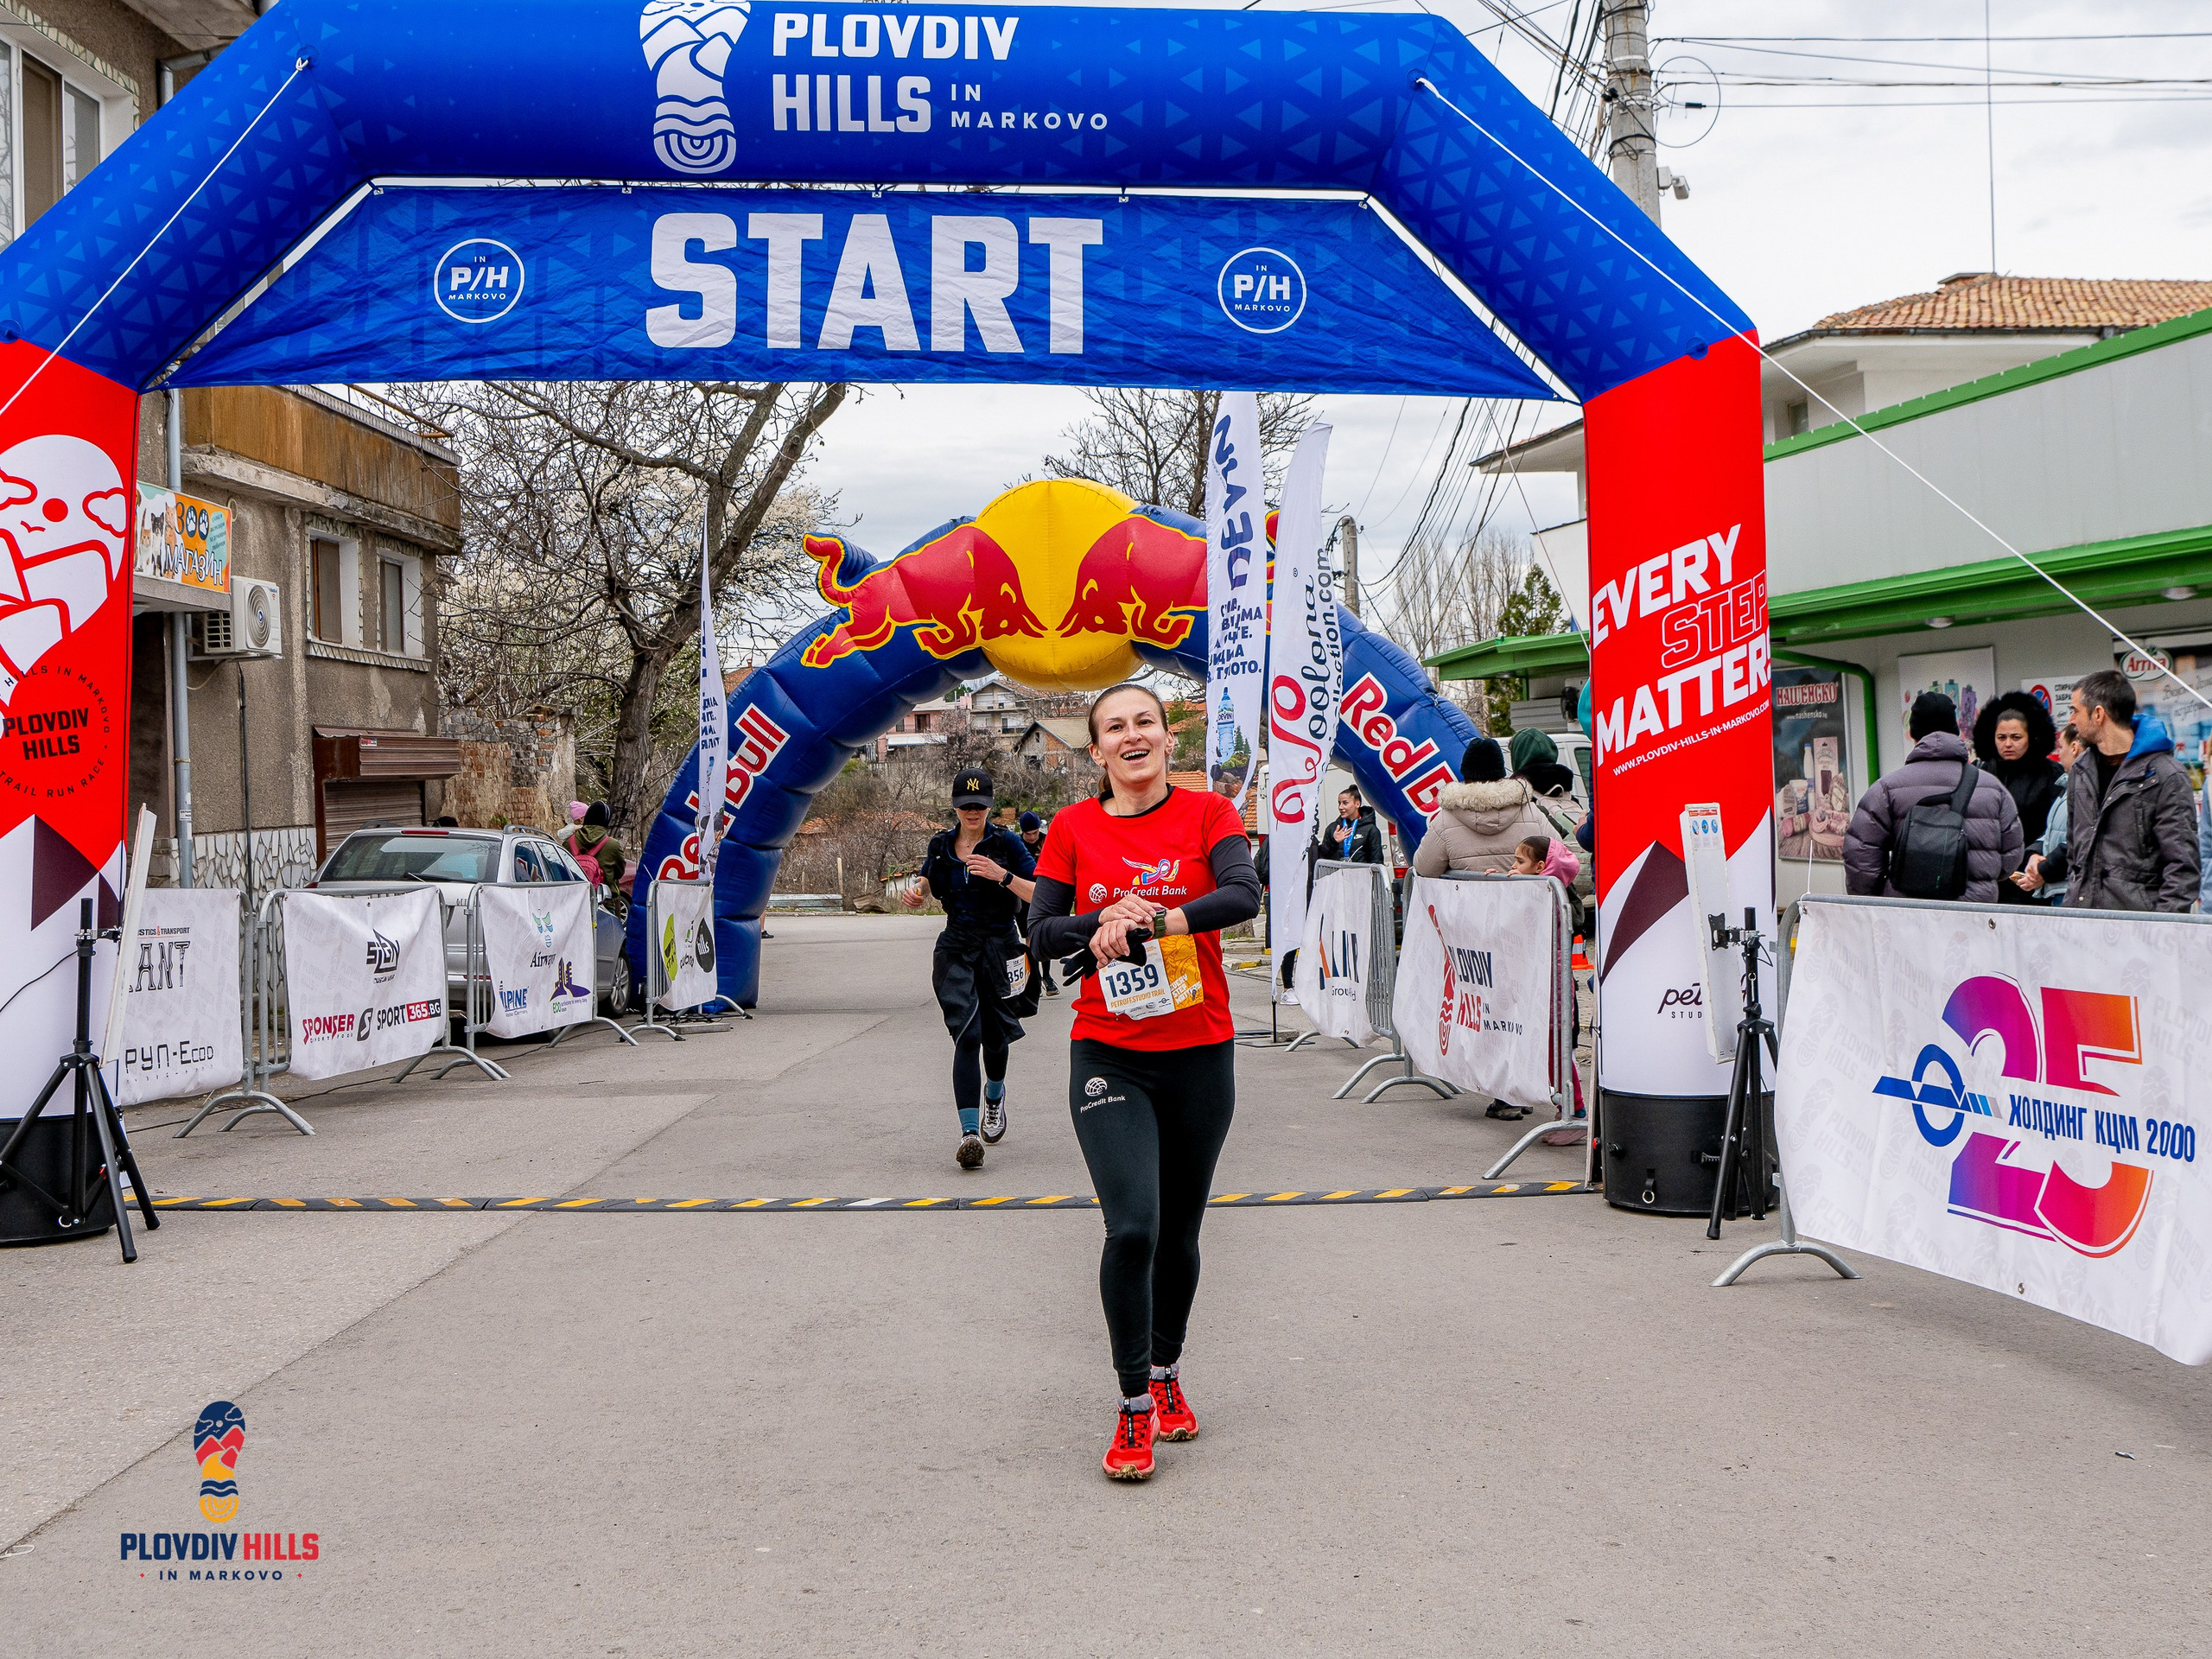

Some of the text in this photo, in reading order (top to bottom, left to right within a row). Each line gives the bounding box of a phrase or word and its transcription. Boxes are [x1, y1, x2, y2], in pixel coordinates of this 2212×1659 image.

[772, 12, 1020, 61] PLOVDIV
[772, 73, 931, 133] HILLS
[950, 84, 982, 101] IN
[950, 111, 1108, 130] MARKOVO
[450, 266, 509, 291] P/H
[645, 212, 1103, 354] START
[1234, 274, 1290, 302] P/H
[165, 543, 223, 586] МАГАЗИН
[1592, 523, 1741, 650] EVERY
[1661, 569, 1767, 669] STEP
[57, 666, 72, 676] IN
[78, 674, 110, 733] MARKOVO
[1776, 683, 1837, 707] НАШЕНСКО
[3, 708, 89, 738] PLOVDIV
[1339, 677, 1436, 779] Red
[22, 734, 80, 760] HILLS
[724, 707, 786, 805] Bull
[47, 785, 75, 798] RUN
[80, 758, 105, 788] RACE
[1113, 885, 1187, 898] ProCredit Bank
[161, 926, 190, 936] TRANSPORT
[129, 940, 191, 993] ANT
[1105, 963, 1160, 998] 1359
[1151, 988, 1166, 998] TRAIL
[1080, 1098, 1106, 1114] ProCredit
[2008, 1093, 2196, 1164] ХОЛДИНГ КЦМ 2000
